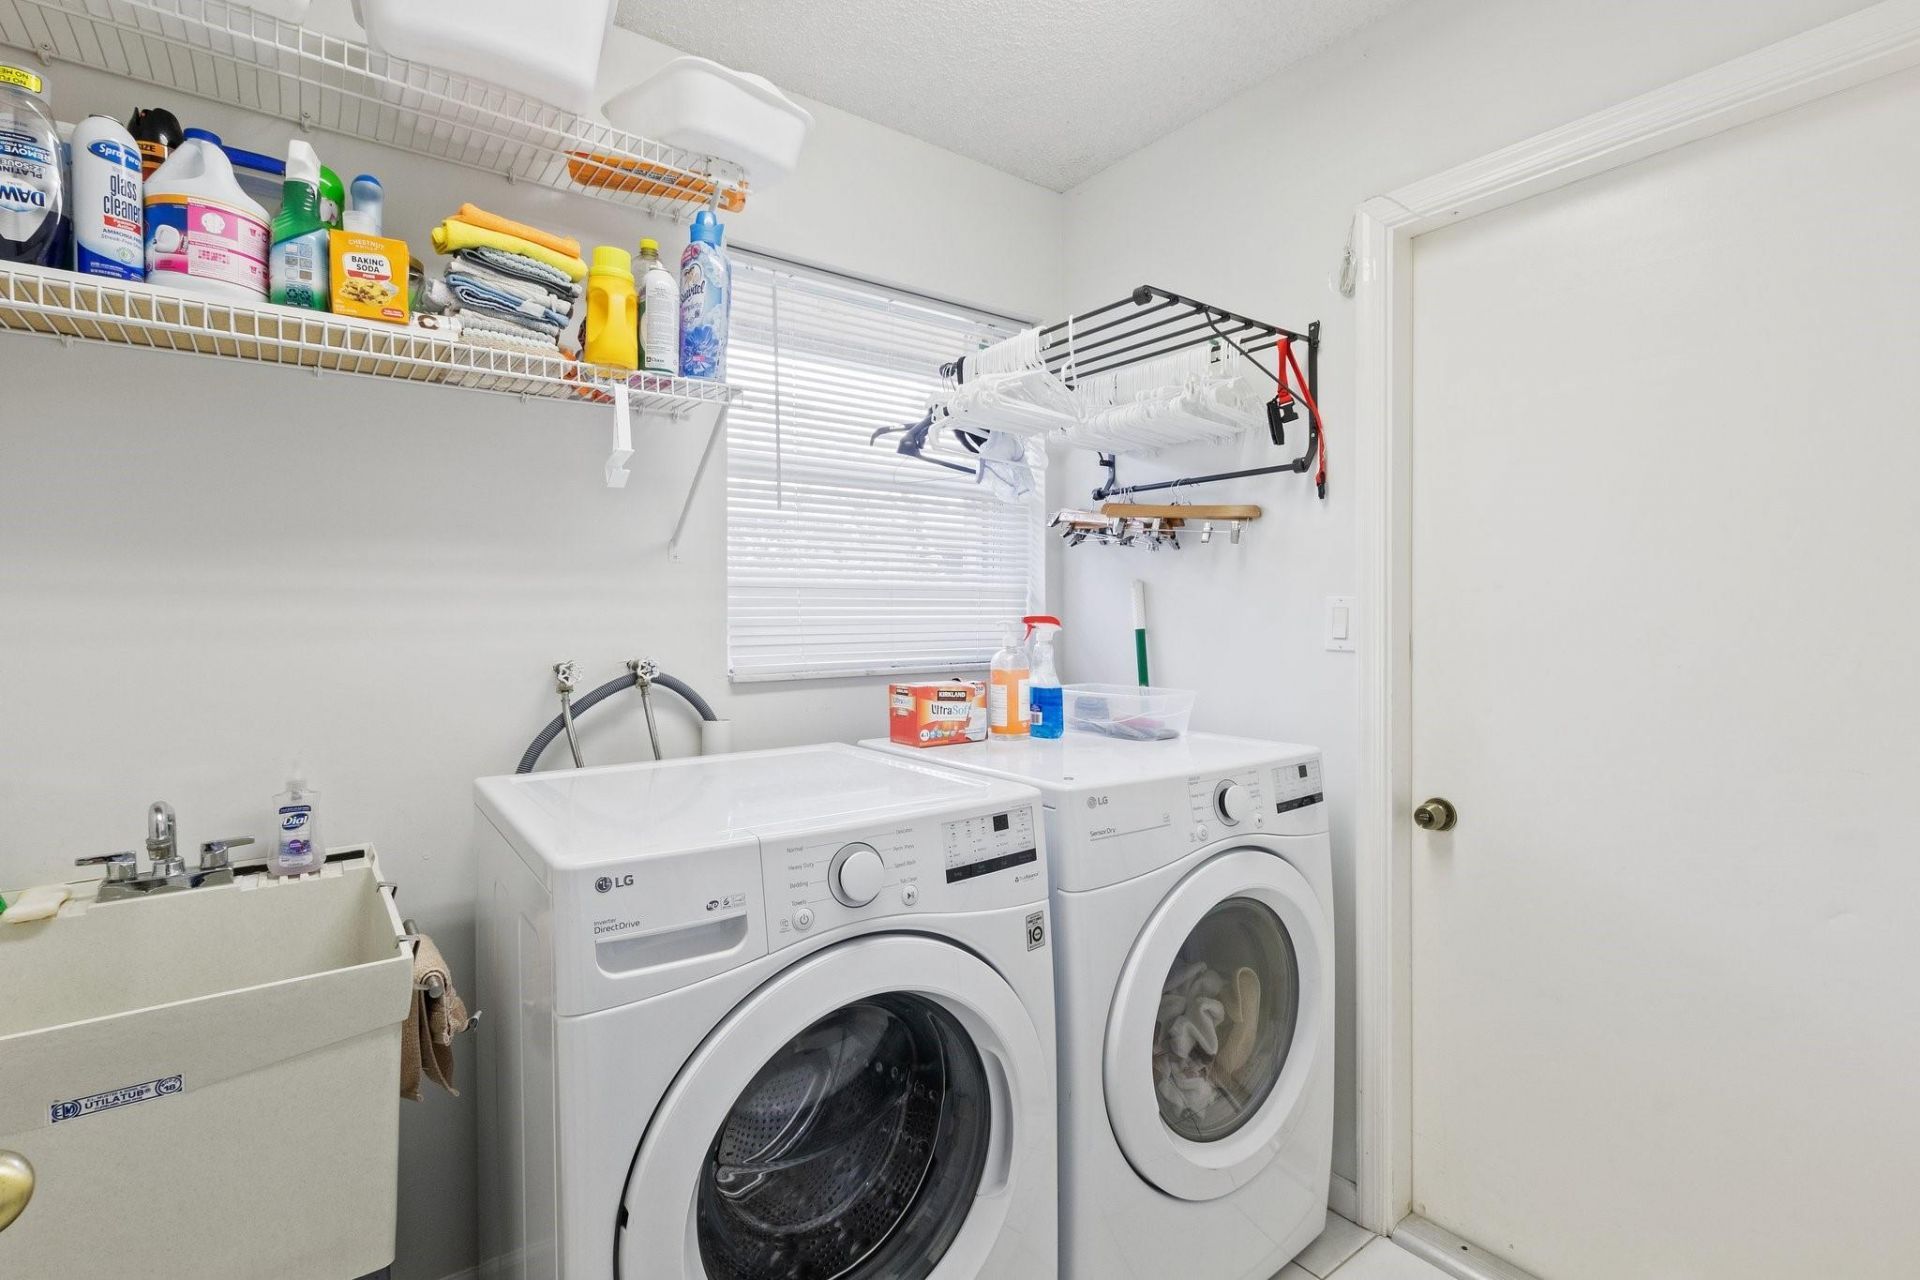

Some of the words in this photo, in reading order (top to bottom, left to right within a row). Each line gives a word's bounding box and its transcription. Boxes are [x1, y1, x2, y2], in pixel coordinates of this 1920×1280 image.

[99, 143, 140, 166] Sprawa
[110, 174, 137, 201] glass
[0, 184, 45, 208] DAW
[103, 195, 142, 224] cleaner
[351, 255, 385, 267] BAKING
[356, 263, 381, 274] SODA
[1097, 796, 1109, 806] LG
[282, 814, 309, 827] Dial
[614, 874, 635, 889] LG
[164, 1084, 177, 1092] 18
